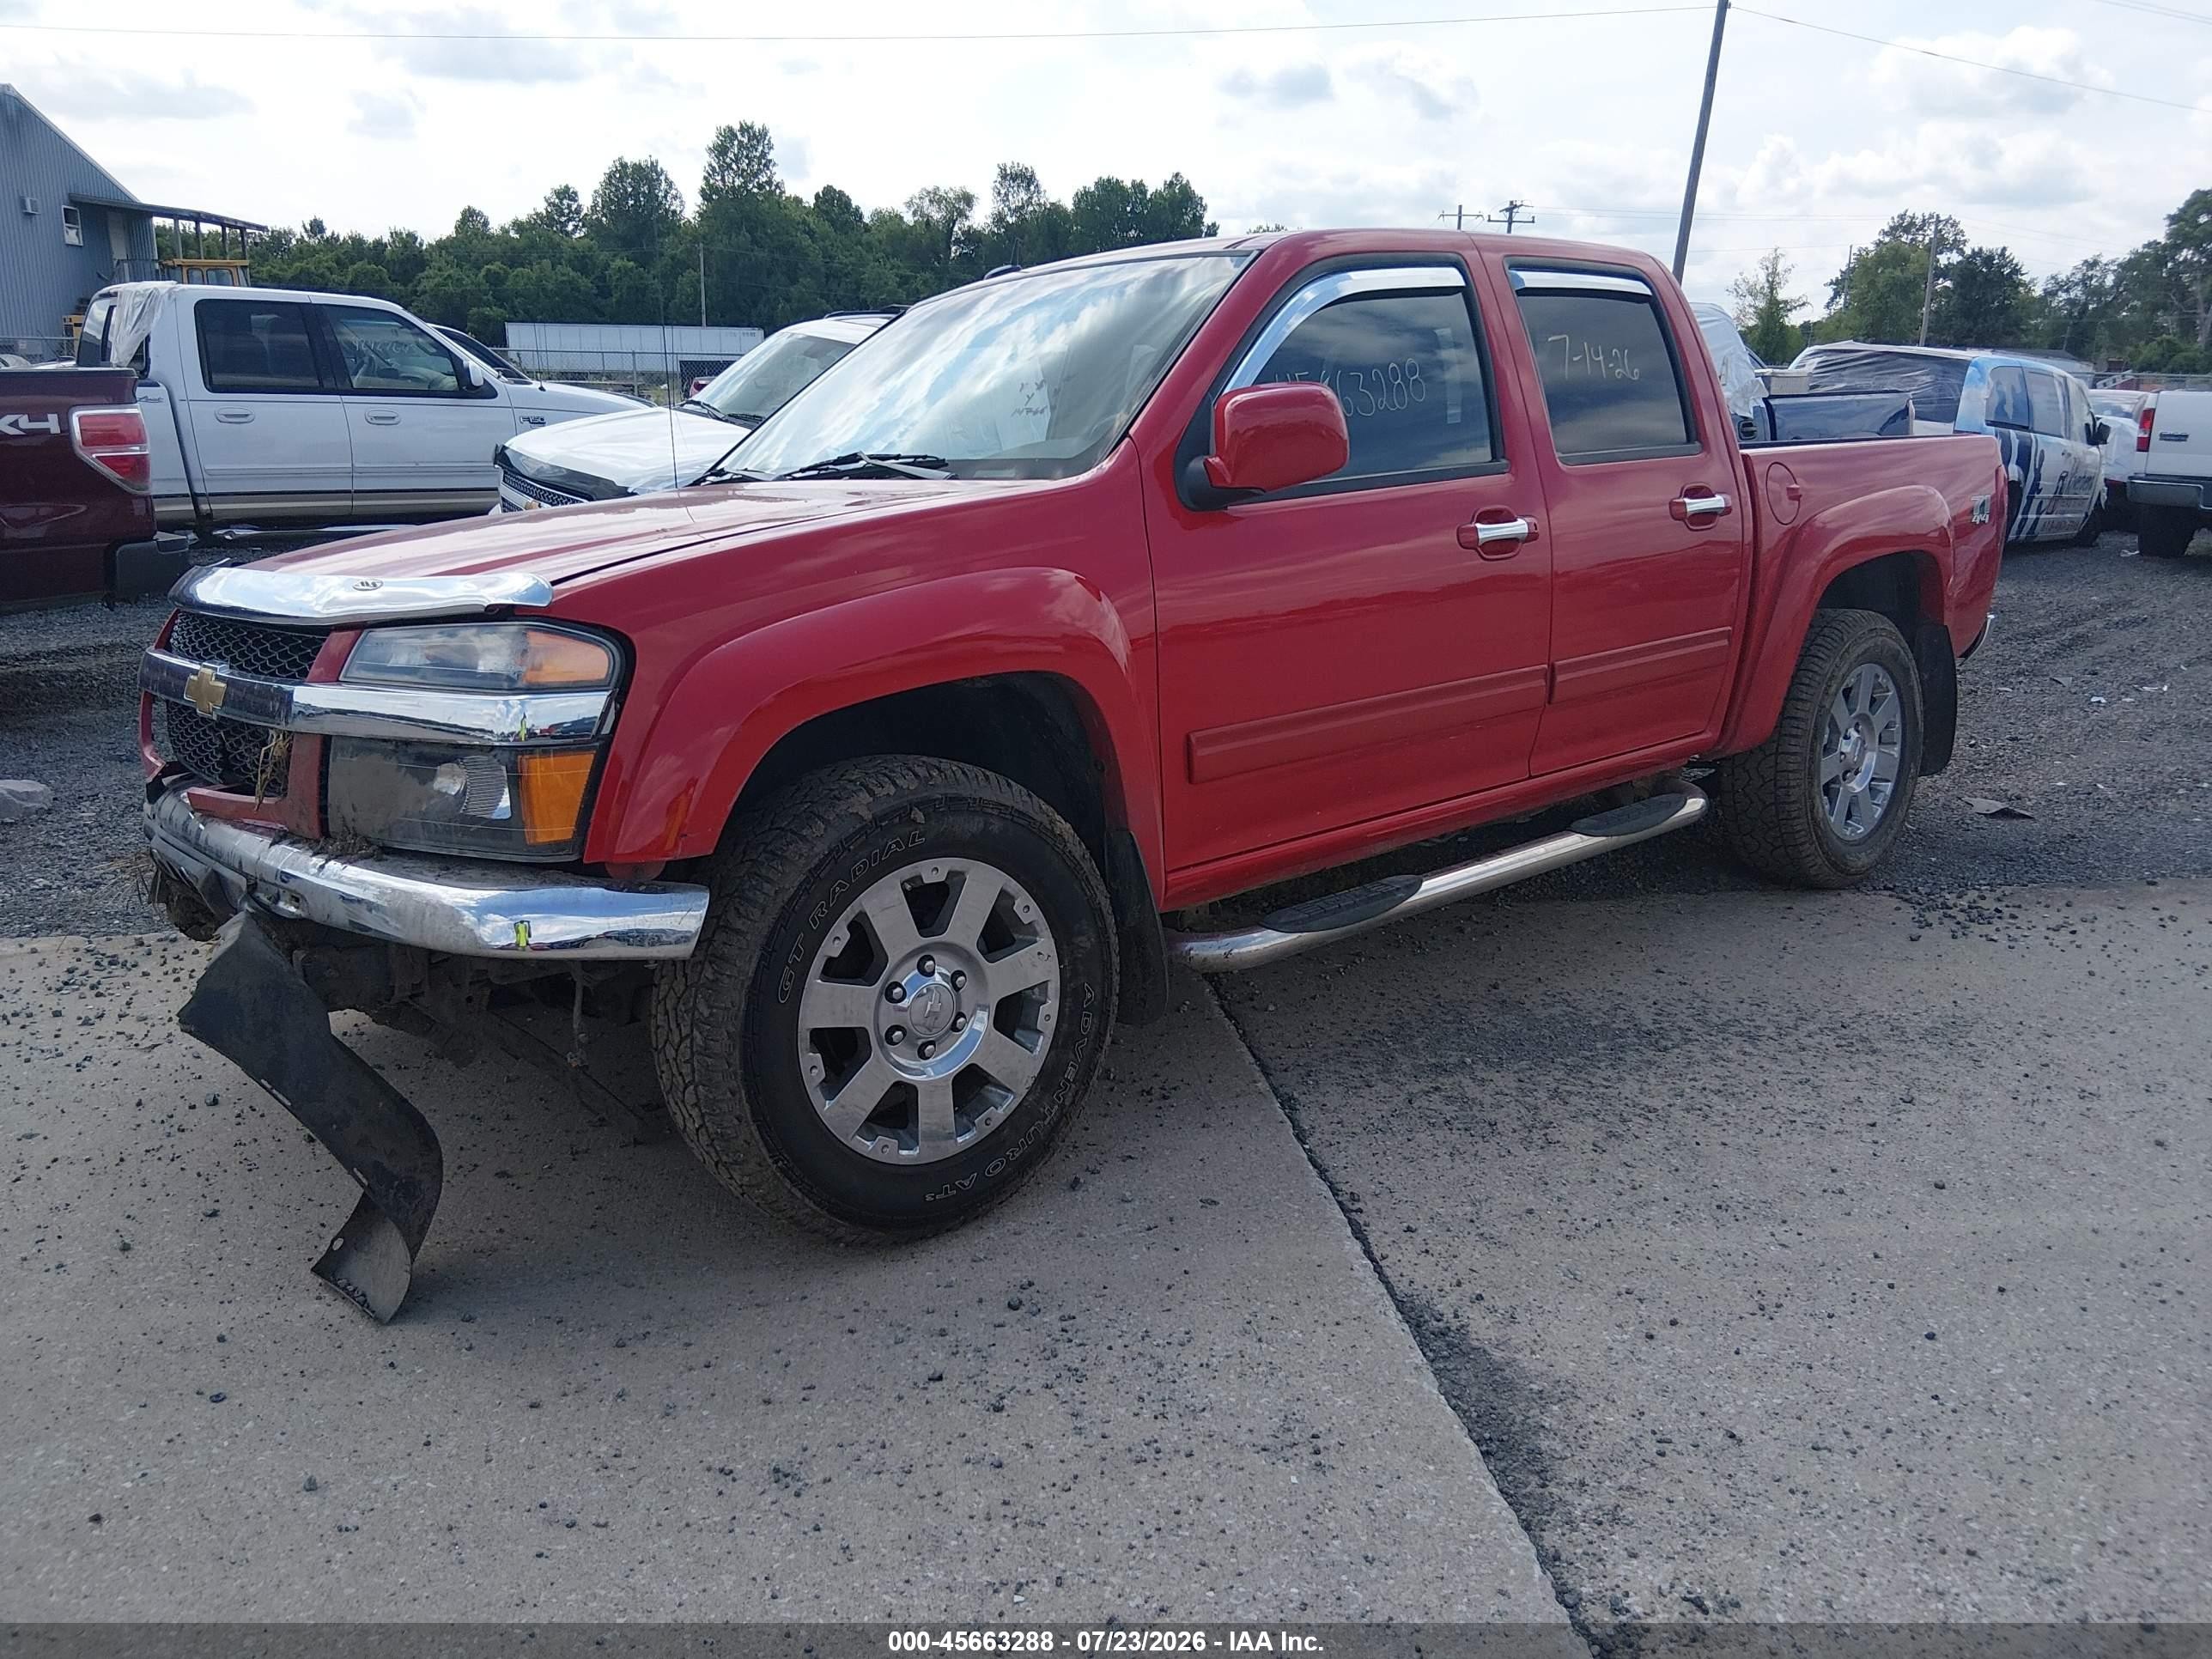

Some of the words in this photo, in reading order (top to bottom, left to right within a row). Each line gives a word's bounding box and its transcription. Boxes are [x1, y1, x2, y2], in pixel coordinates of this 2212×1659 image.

[1275, 358, 1426, 417] 63288
[1547, 334, 1640, 380] 7-14-26
[778, 932, 805, 1004] GT
[808, 830, 926, 930] RADIAL
[985, 981, 1095, 1177] ADVENTURO
